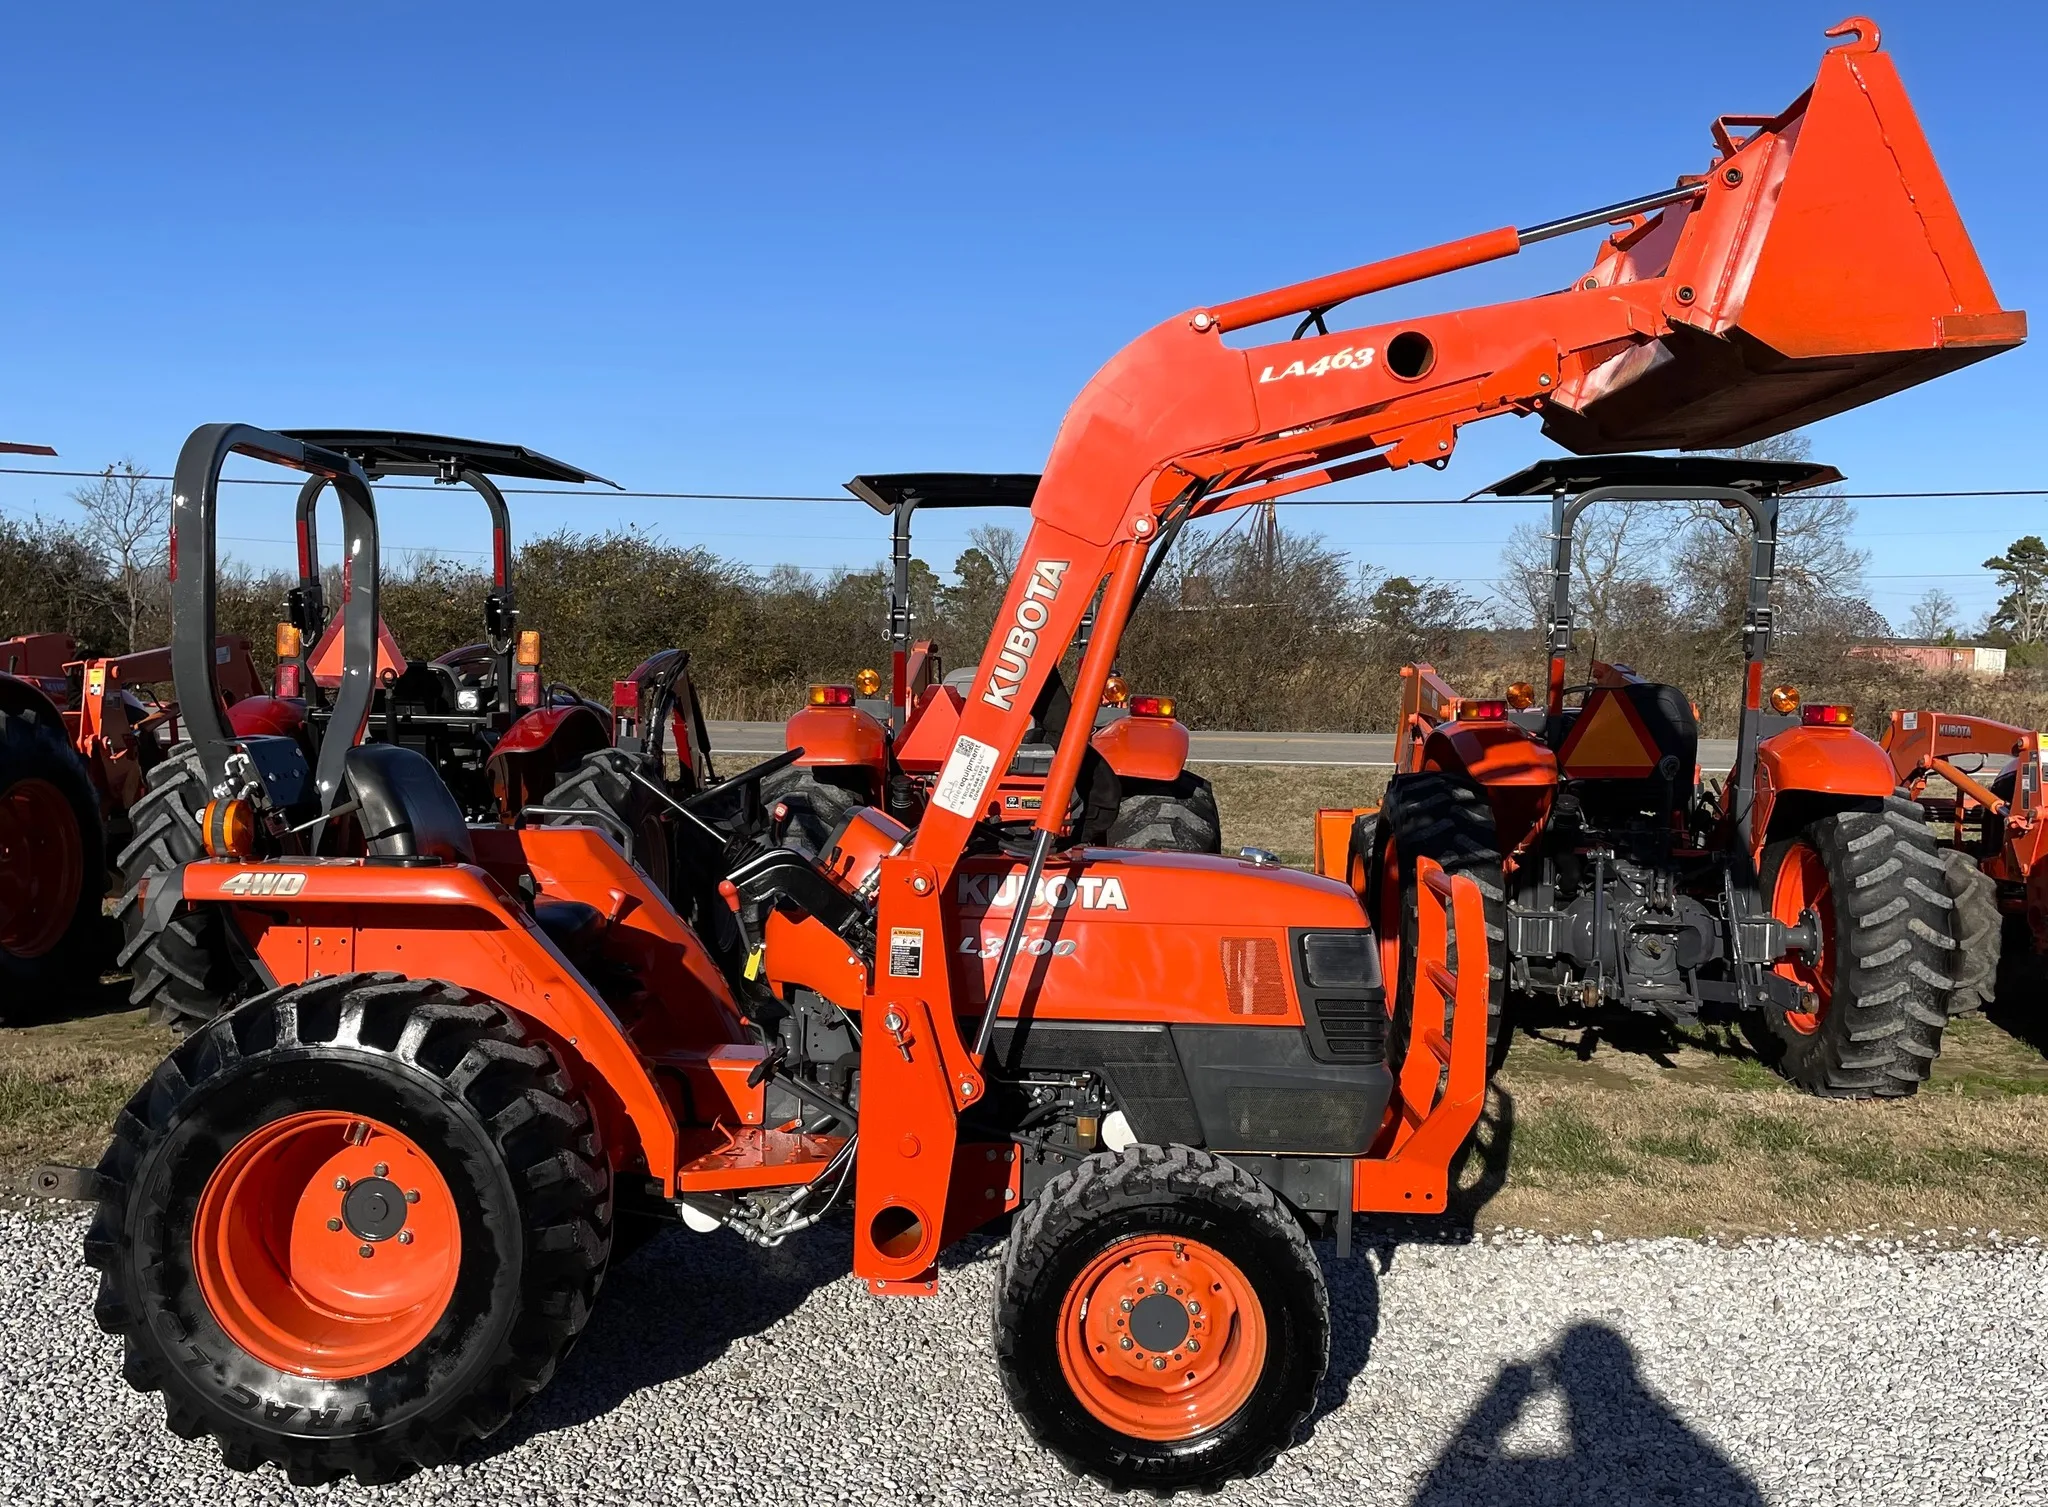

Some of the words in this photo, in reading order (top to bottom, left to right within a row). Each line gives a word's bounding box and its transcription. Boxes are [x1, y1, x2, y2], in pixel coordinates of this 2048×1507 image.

[1259, 347, 1375, 383] LA463
[982, 560, 1071, 712] KUBOTA
[1939, 724, 1972, 738] KUBOTA
[220, 871, 306, 897] 4WD
[957, 873, 1128, 911] KUBOTA
[220, 1384, 374, 1430] TRAC
